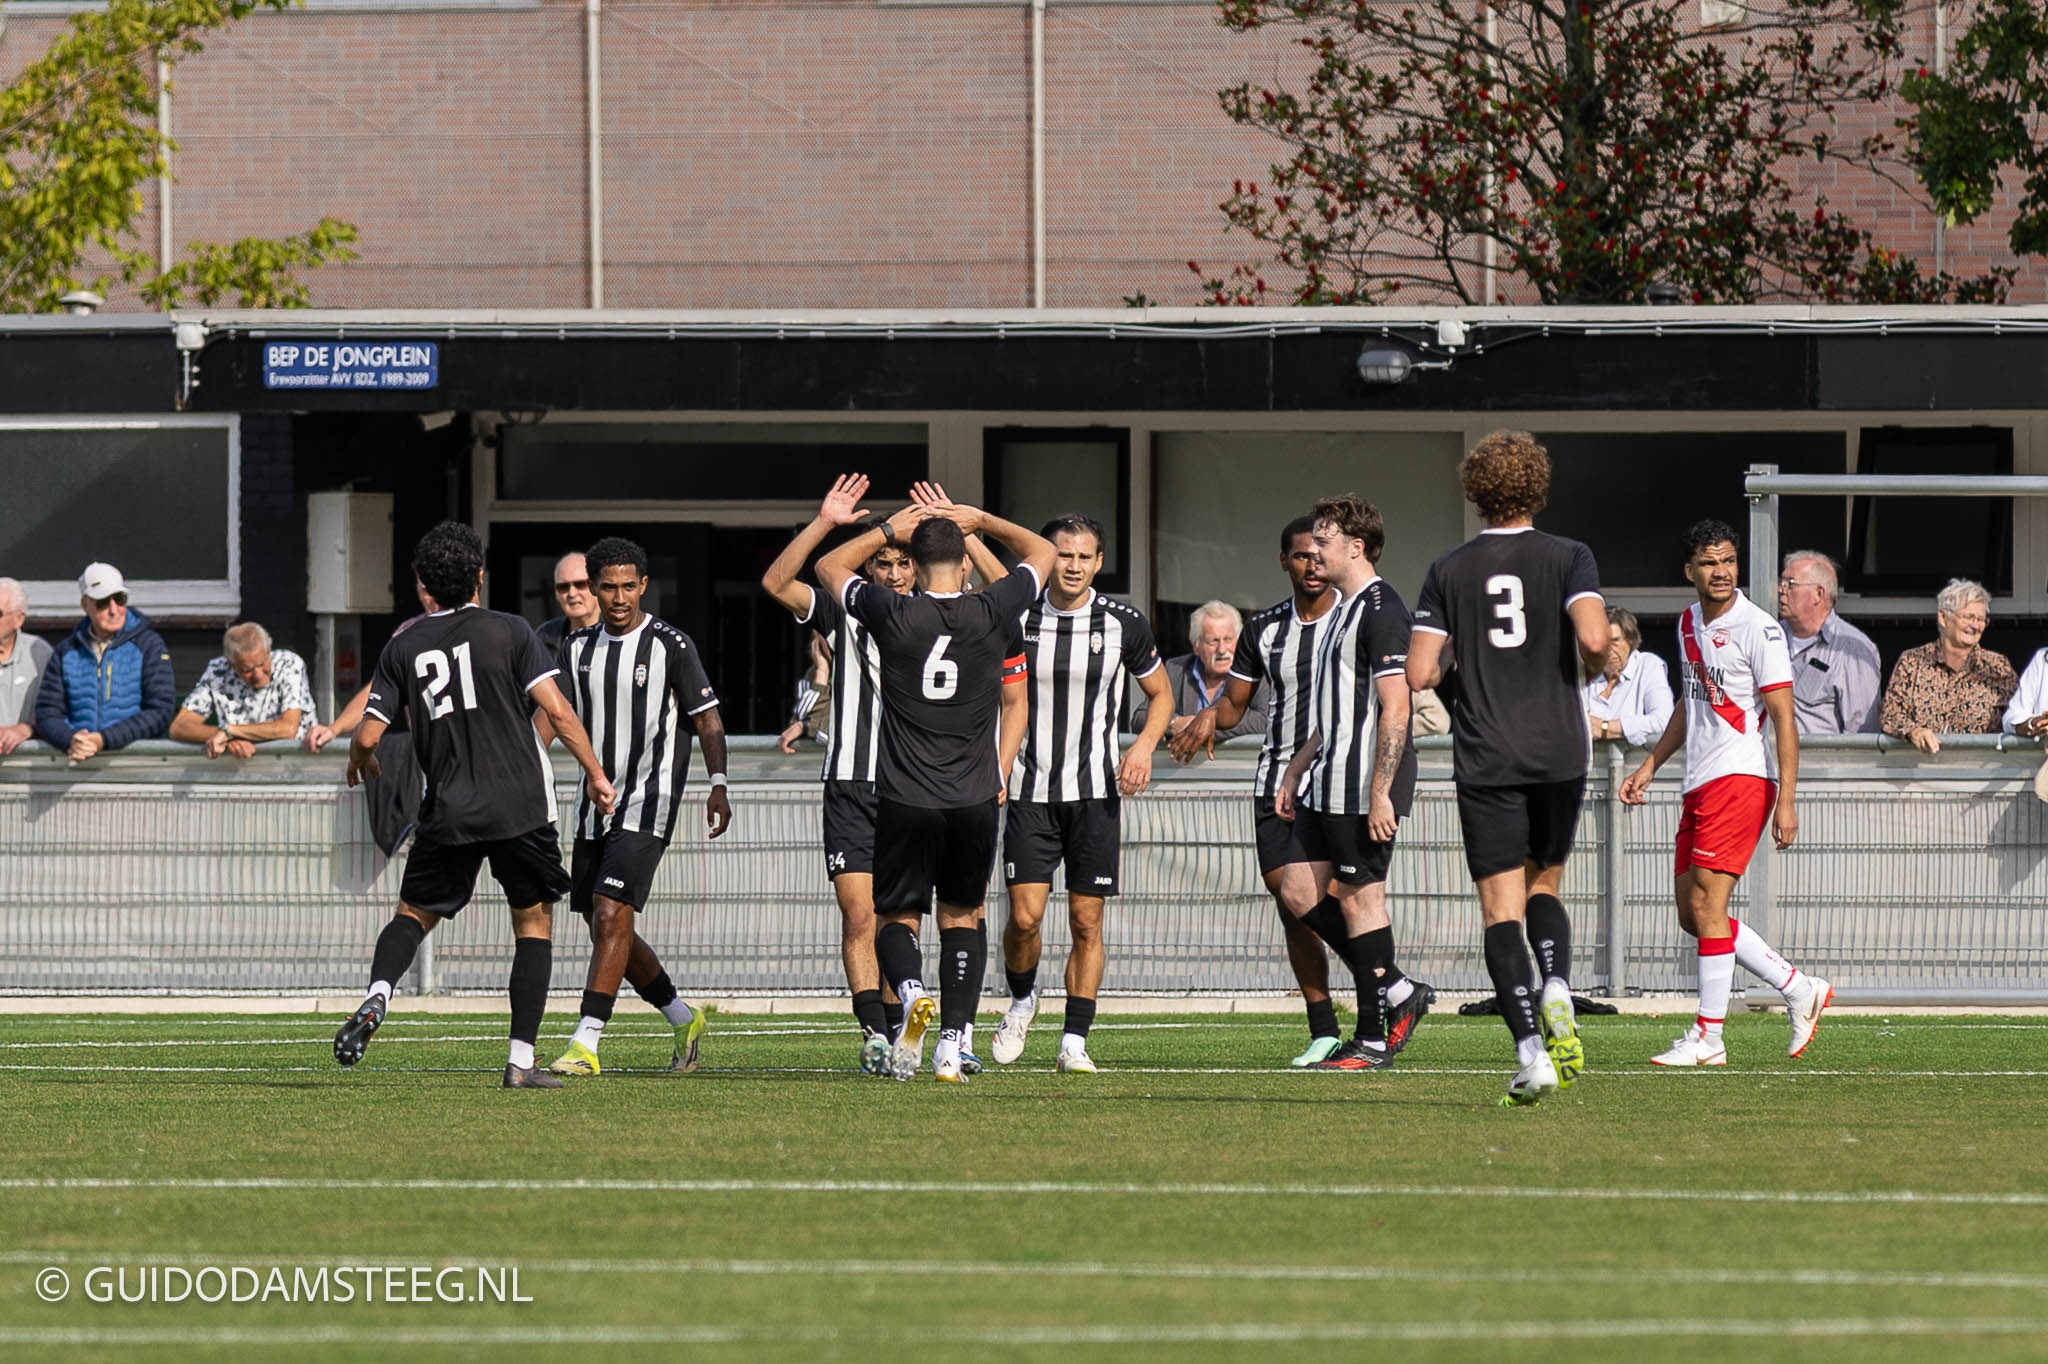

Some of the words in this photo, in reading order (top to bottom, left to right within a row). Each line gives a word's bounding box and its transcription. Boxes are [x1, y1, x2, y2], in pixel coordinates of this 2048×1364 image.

[268, 346, 299, 367] BEP
[304, 346, 329, 367] DE
[332, 346, 430, 371] JONGPLEIN
[1486, 574, 1527, 648] 3
[415, 641, 478, 720] 21
[922, 635, 958, 700] 6
[828, 851, 846, 871] 24
